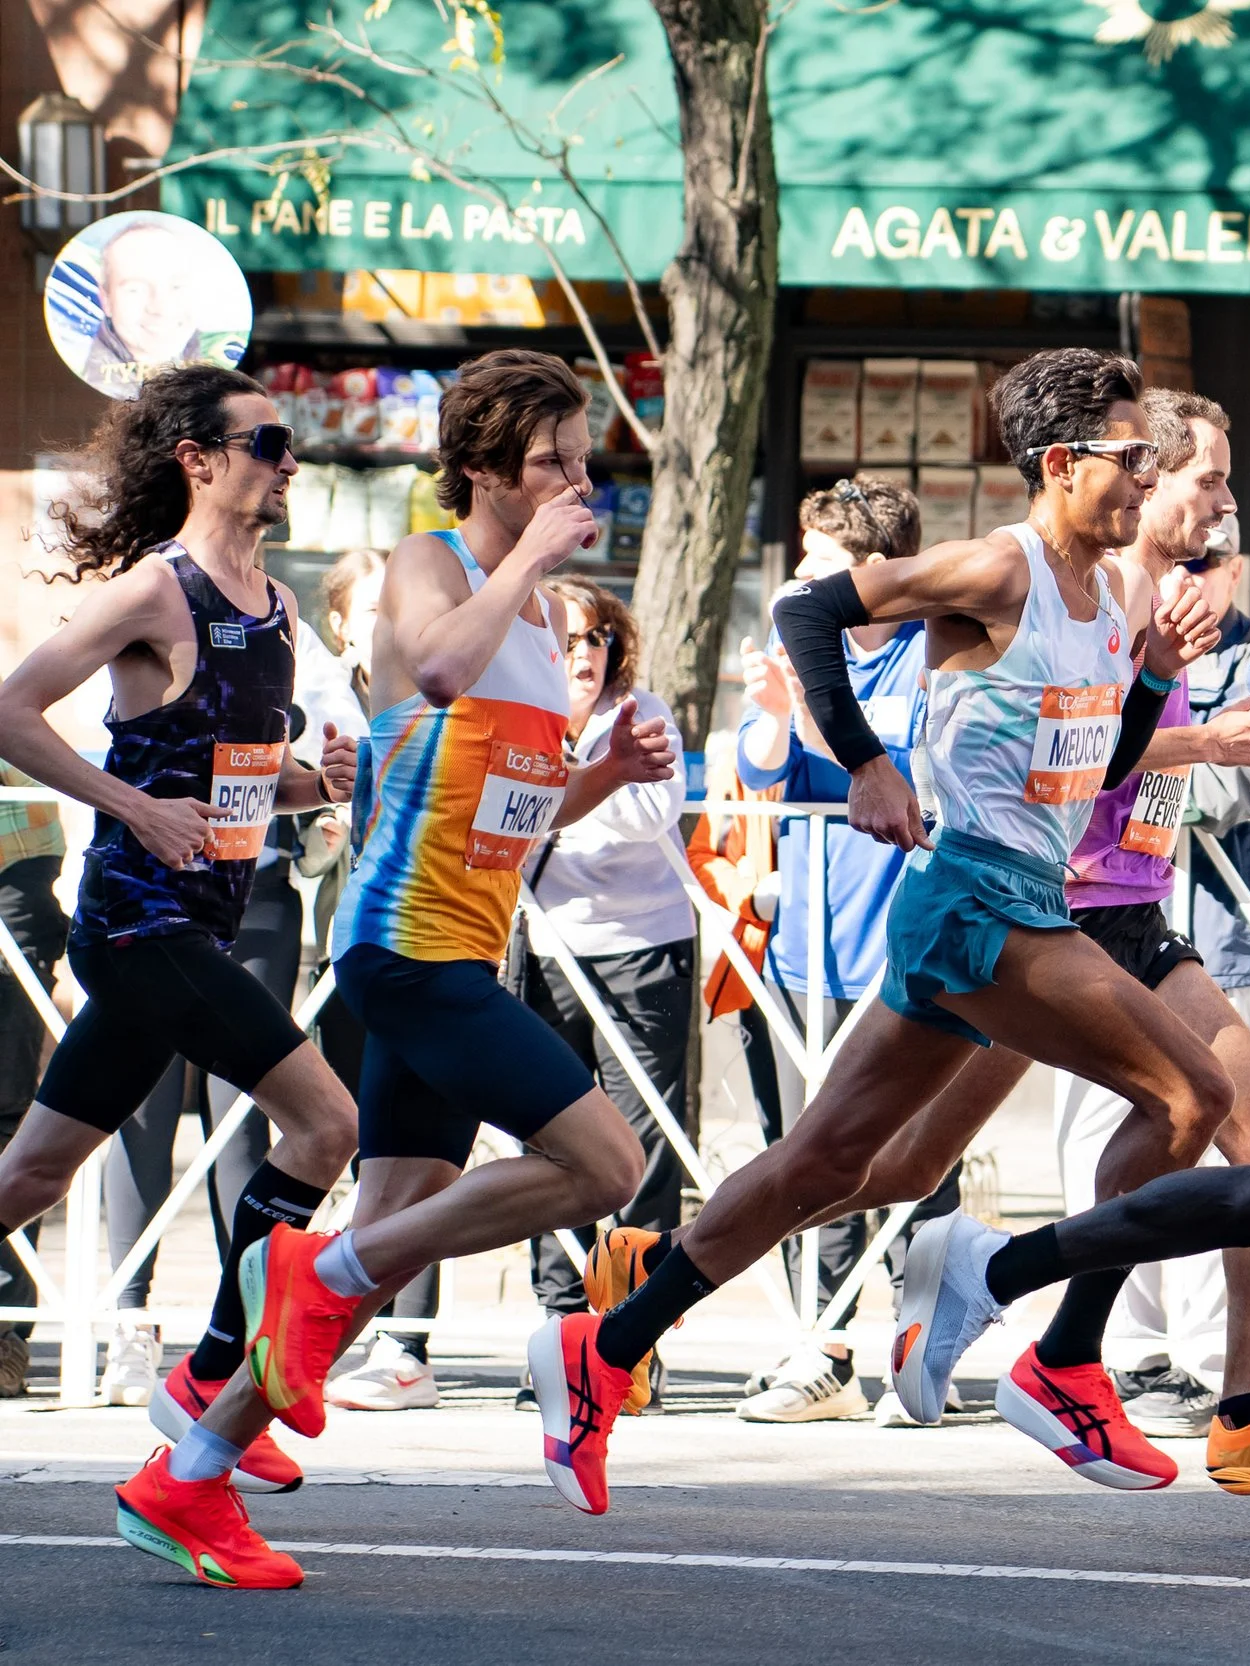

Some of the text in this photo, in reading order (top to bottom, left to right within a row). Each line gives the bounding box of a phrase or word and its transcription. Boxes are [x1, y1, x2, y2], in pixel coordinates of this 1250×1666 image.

[205, 198, 587, 245] IL PANE E LA PASTA
[831, 206, 1029, 261] AGATA
[1040, 215, 1088, 261] &
[230, 748, 252, 767] tcs
[506, 748, 532, 772] tcs
[1048, 725, 1109, 767] MEUCCI
[217, 782, 278, 822] REICHO
[500, 790, 553, 833] HICKS
